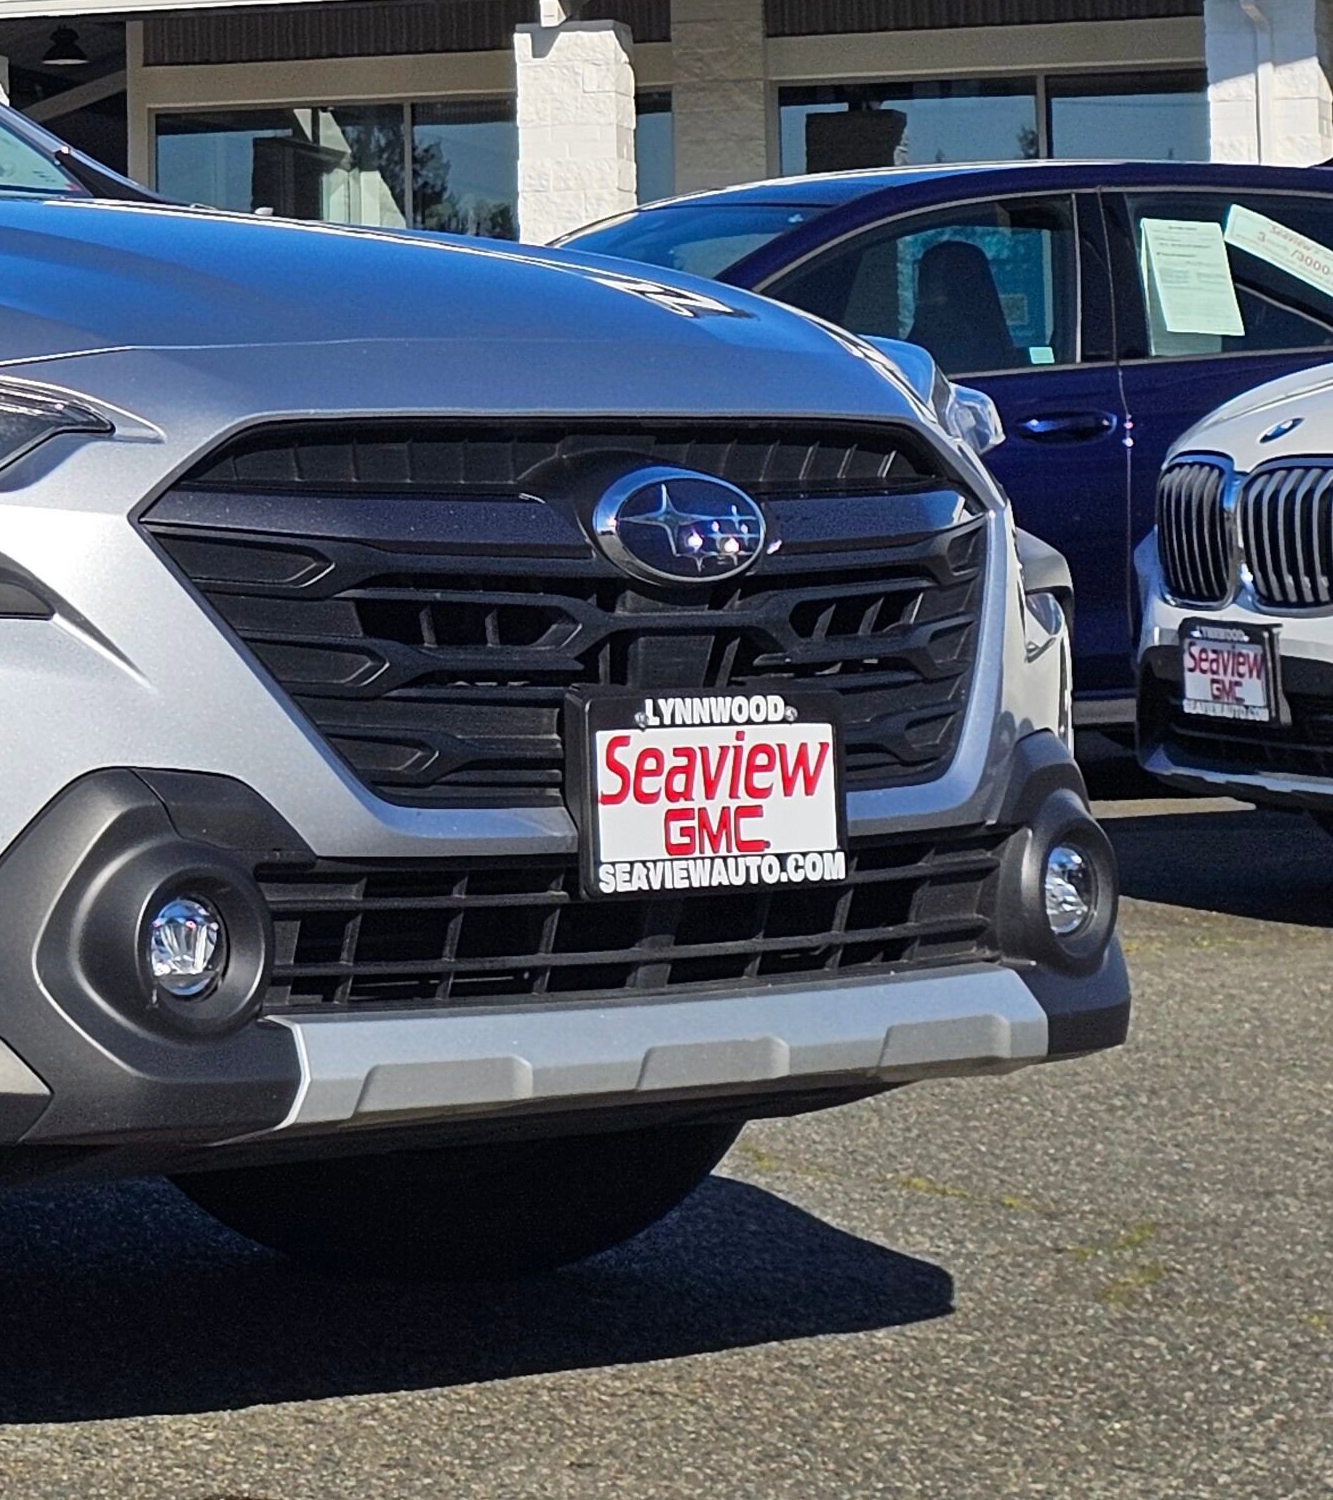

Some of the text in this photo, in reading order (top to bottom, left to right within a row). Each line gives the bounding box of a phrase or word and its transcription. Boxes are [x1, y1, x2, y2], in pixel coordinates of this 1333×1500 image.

[1188, 642, 1264, 679] Seaview
[645, 696, 784, 726] LYNNWOOD
[1211, 679, 1245, 704] GMC
[599, 730, 830, 805] Seaview
[664, 805, 769, 857] GMC
[599, 851, 846, 894] SEAVIEWAUTO.COM
